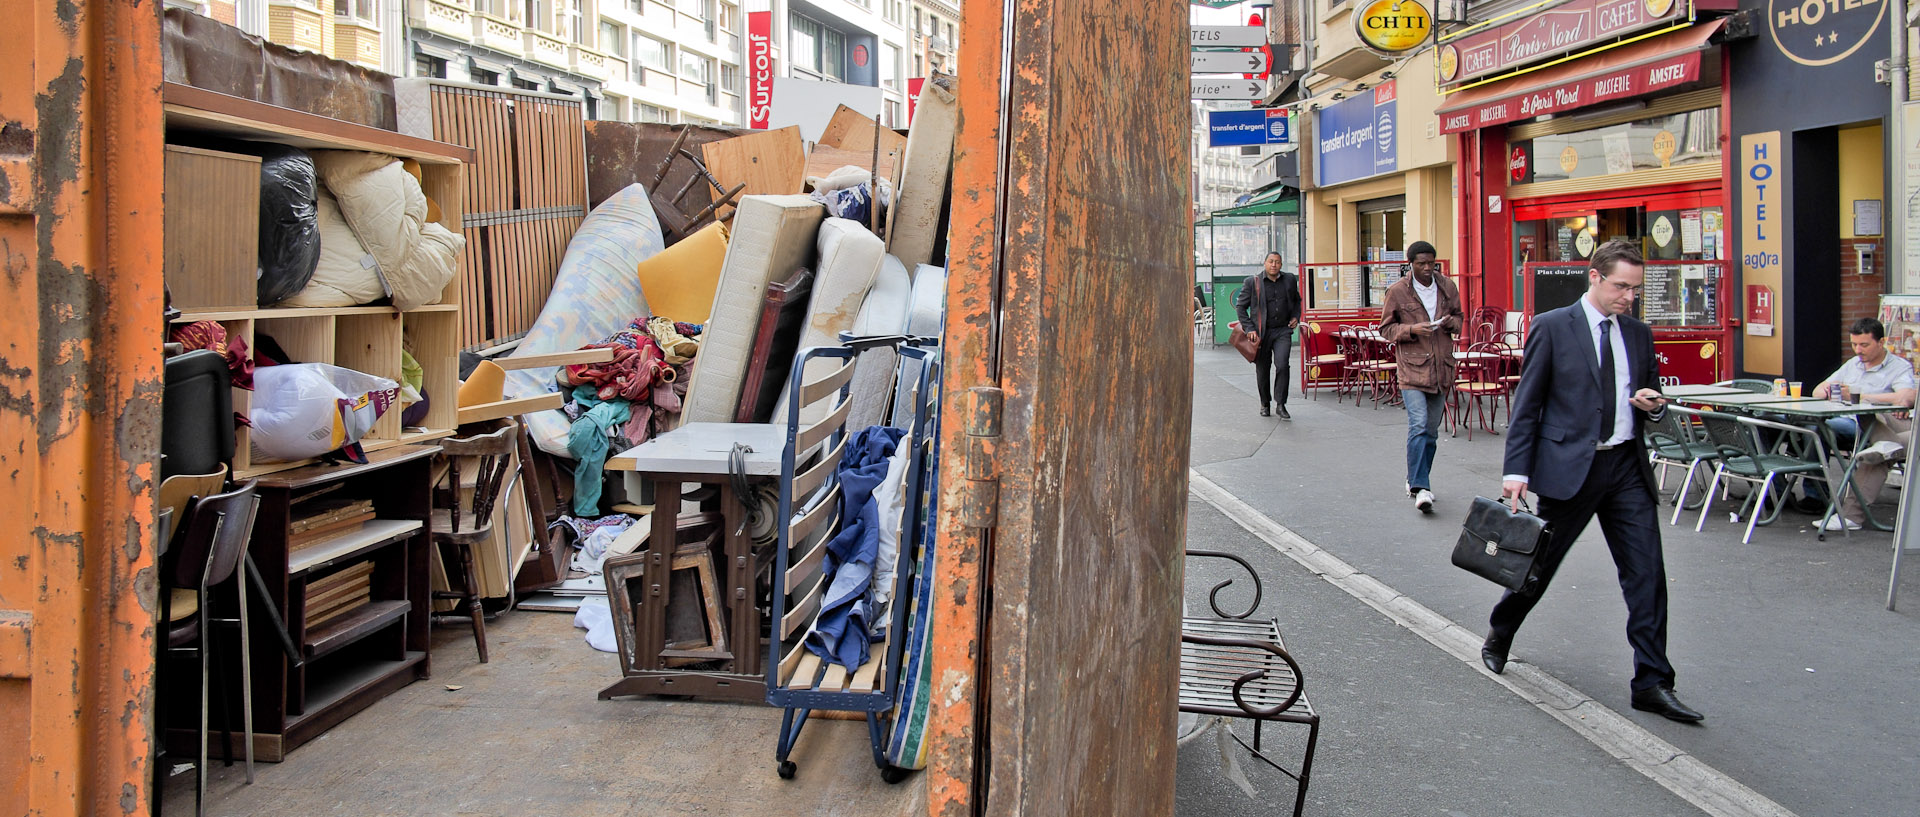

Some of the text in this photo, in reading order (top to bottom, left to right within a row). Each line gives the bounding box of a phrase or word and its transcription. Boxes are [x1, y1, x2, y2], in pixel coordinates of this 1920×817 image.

[1367, 15, 1424, 29] CH'TI
[1600, 1, 1637, 31] CAFE
[1506, 14, 1584, 61] Paris Nord
[1465, 48, 1493, 72] CAFE
[750, 33, 771, 122] Surcouf
[1521, 97, 1530, 114] Le
[1530, 92, 1552, 114] Paris
[1556, 85, 1579, 106] Nord
[1649, 63, 1685, 86] AMSTEL
[1211, 123, 1265, 132] transfert d'argent
[1321, 130, 1345, 154] transfert
[1750, 143, 1772, 240] HOTEL
[1757, 292, 1769, 307] H
